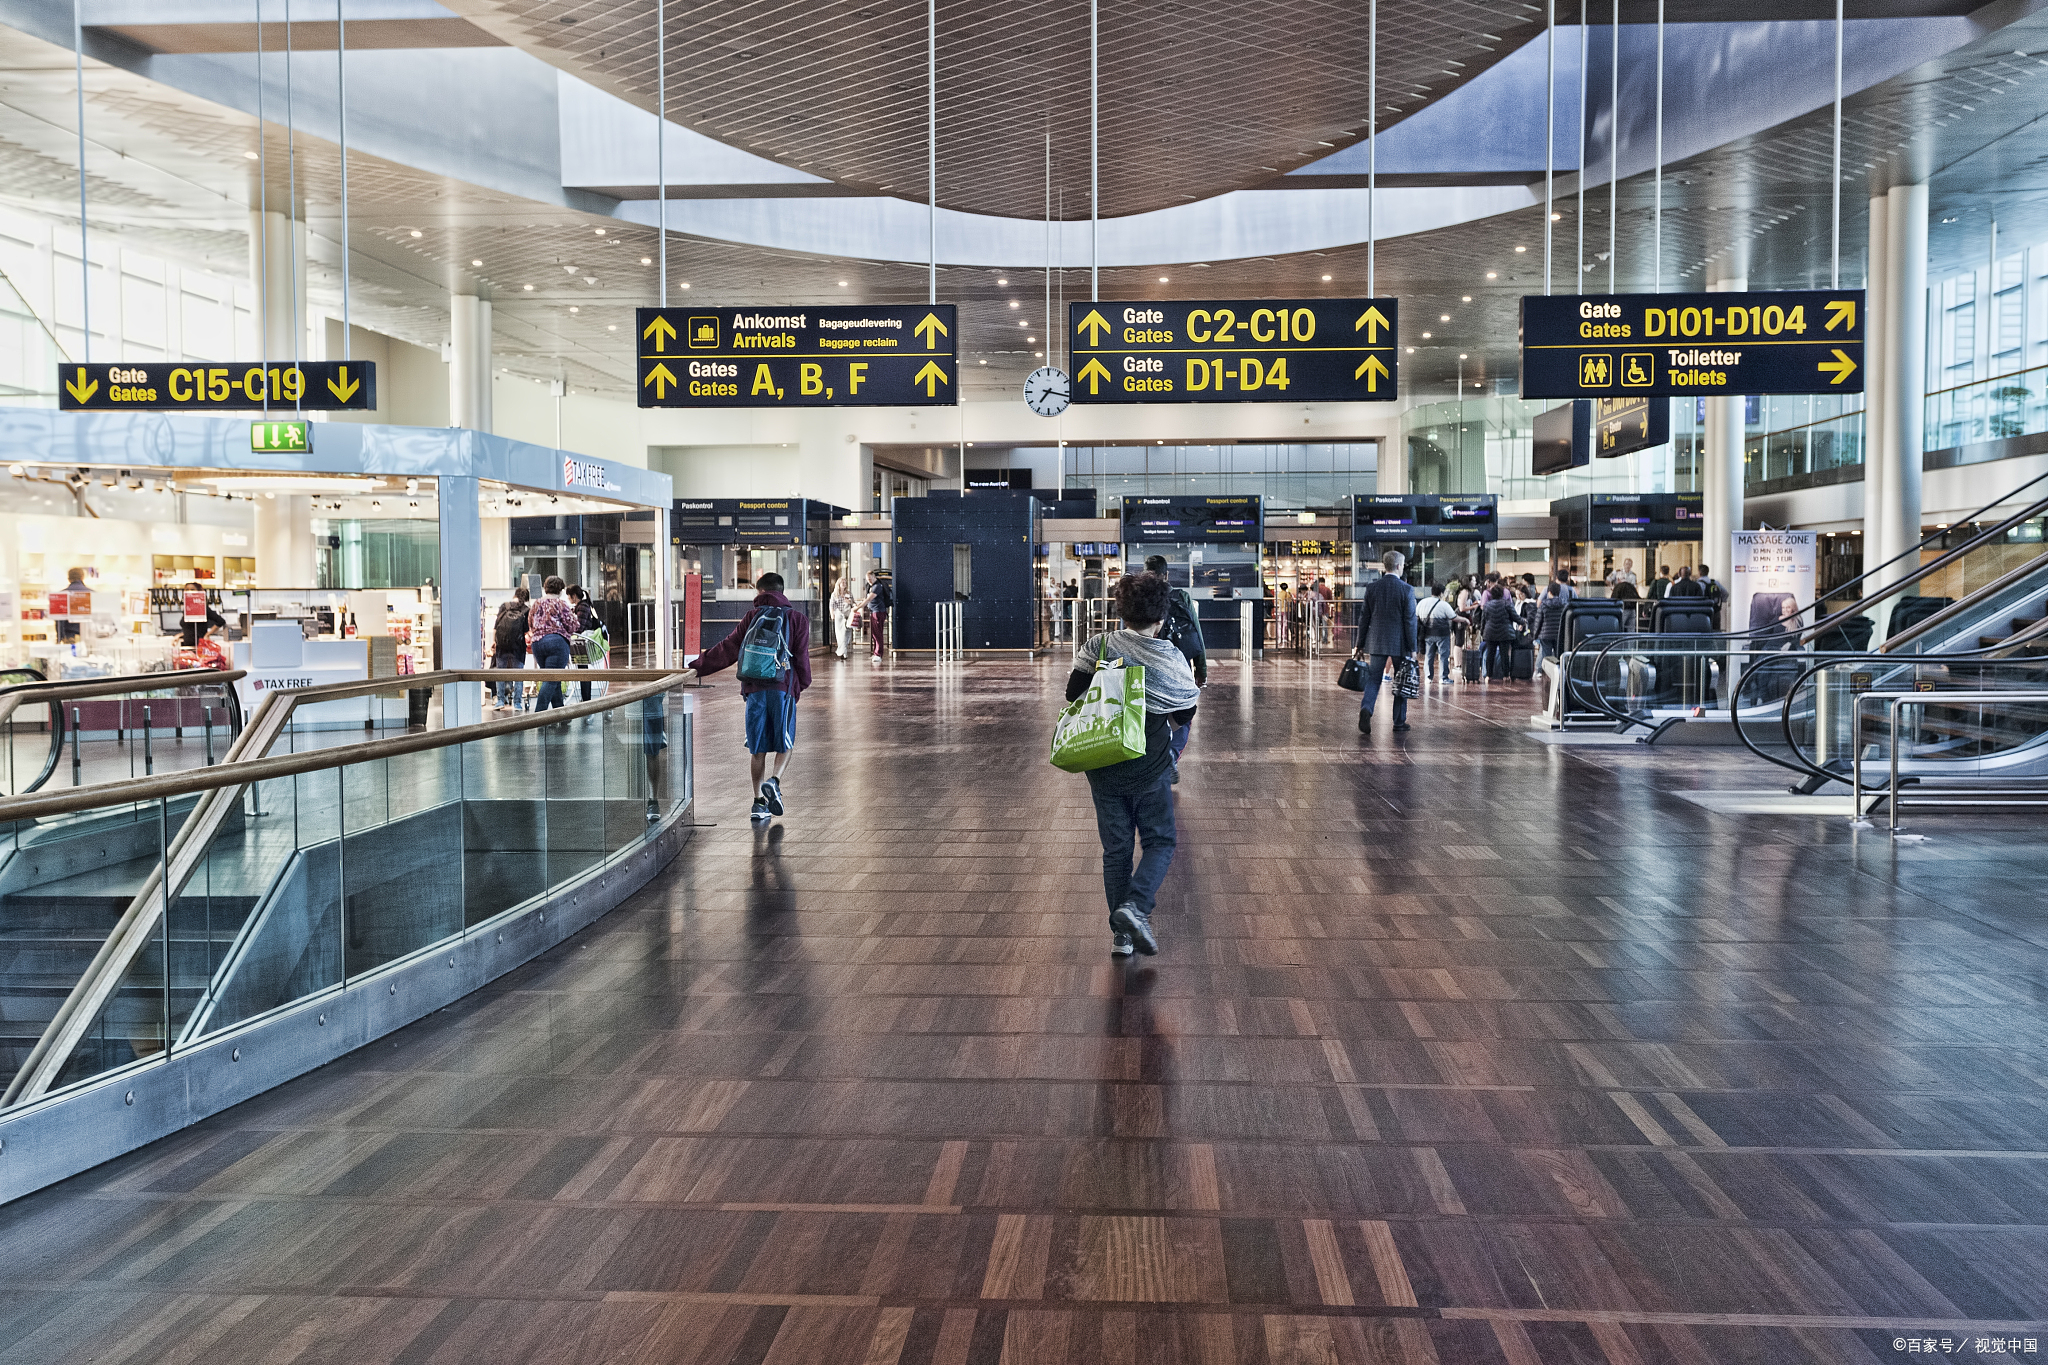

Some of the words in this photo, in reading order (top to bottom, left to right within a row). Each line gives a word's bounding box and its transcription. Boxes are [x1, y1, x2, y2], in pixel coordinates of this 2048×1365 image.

[1124, 308, 1163, 324] Gate
[1580, 301, 1621, 318] Gate
[732, 314, 806, 329] Ankomst
[819, 318, 902, 330] Bagageudlevering
[1186, 308, 1316, 342] C2-C10
[1645, 305, 1806, 337] D101-D104
[1124, 328, 1173, 343] Gates
[1580, 321, 1631, 338] Gates
[732, 332, 796, 348] Arrivals
[819, 338, 860, 348] Baggage
[864, 337, 897, 347] reclaim
[1124, 356, 1163, 372] Gate
[1668, 350, 1741, 366] Toiletter
[109, 367, 147, 384] Gate
[689, 361, 737, 377] Gates
[1186, 358, 1290, 390] D1-D4
[168, 368, 305, 401] C15-C19
[751, 363, 784, 400] A,
[800, 363, 833, 400] B,
[850, 363, 868, 395] F
[1124, 376, 1173, 392] Gates
[1668, 370, 1726, 386] Toilets
[109, 386, 156, 402] Gates
[689, 381, 737, 396] Gates
[573, 461, 586, 486] TAX
[586, 464, 604, 488] FREE
[681, 502, 713, 510] Paskontrol
[740, 502, 766, 510] Passport
[1739, 536, 1783, 544] MASSAGE
[1785, 535, 1809, 544] ZONE
[264, 680, 284, 689] TAX
[287, 678, 312, 688] FREE
